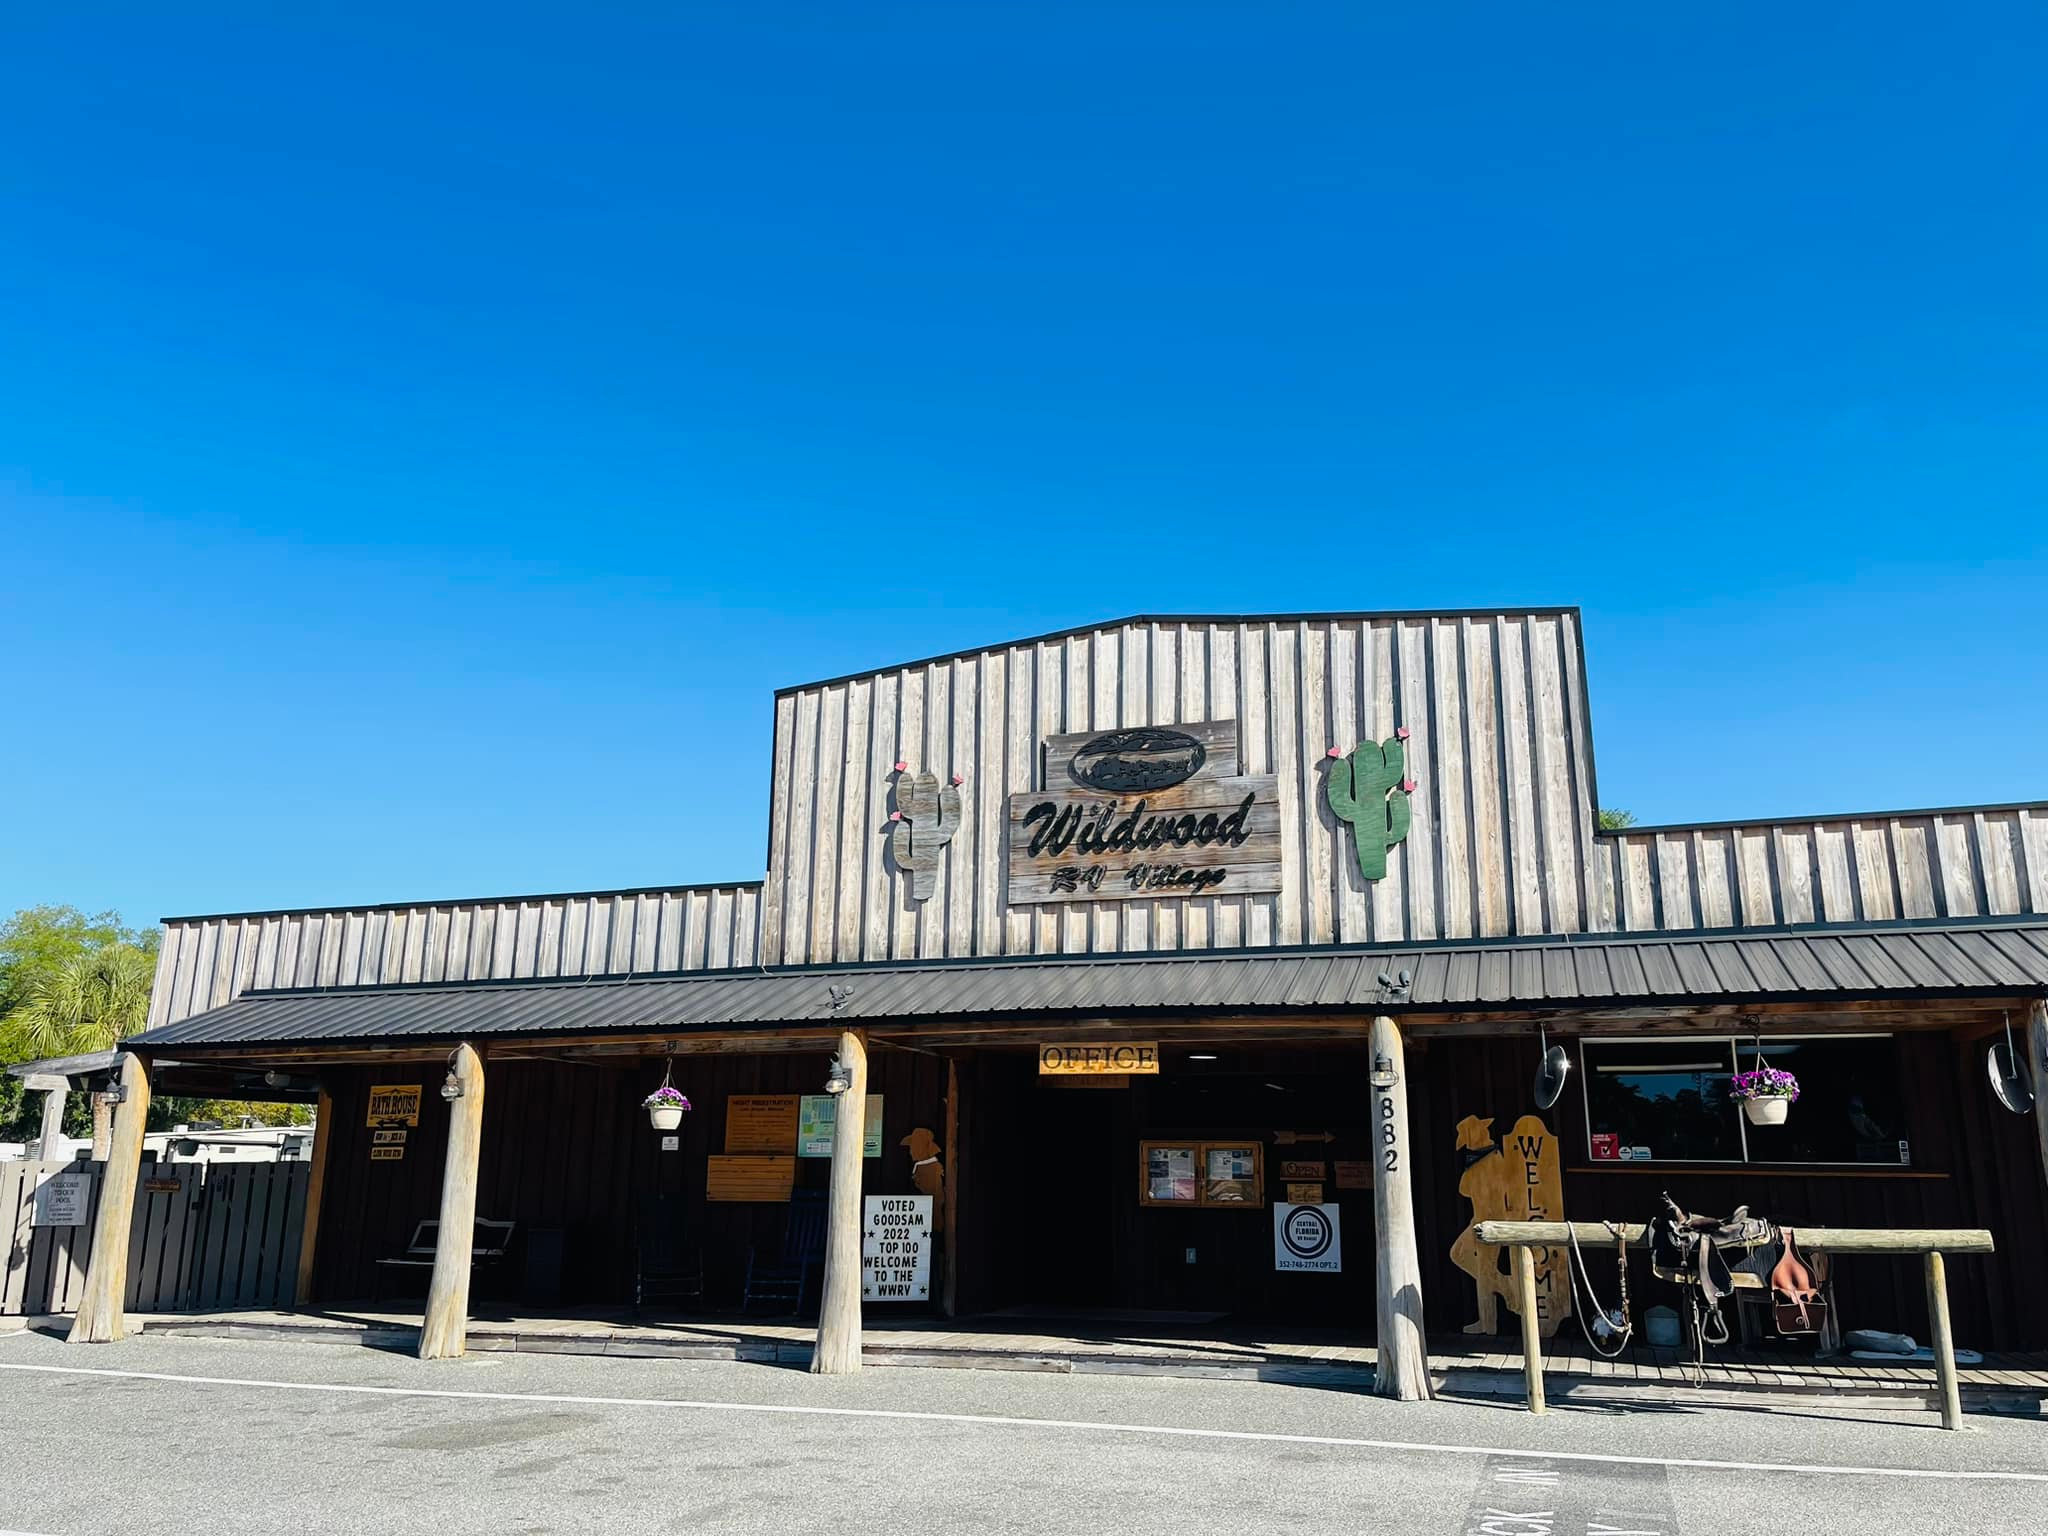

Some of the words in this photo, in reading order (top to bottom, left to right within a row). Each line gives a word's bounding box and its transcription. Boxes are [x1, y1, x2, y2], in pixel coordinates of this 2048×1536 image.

[1023, 791, 1257, 858] Wildwood
[1049, 864, 1107, 894] RV
[1124, 861, 1227, 896] Village
[1042, 1046, 1155, 1072] OFFICE
[371, 1095, 391, 1115] BATH
[391, 1095, 418, 1114] HOUSE
[1381, 1096, 1398, 1173] 882
[881, 1200, 915, 1211] VOTED
[873, 1214, 924, 1226] GOODSAM
[1517, 1135, 1552, 1320] WELOME
[883, 1228, 910, 1240] 2022
[879, 1242, 899, 1254] TOP
[902, 1242, 919, 1254] 100
[864, 1256, 918, 1268] WELCOME
[874, 1270, 888, 1282] TO
[893, 1270, 913, 1282] THE
[878, 1284, 911, 1296] WWRV
